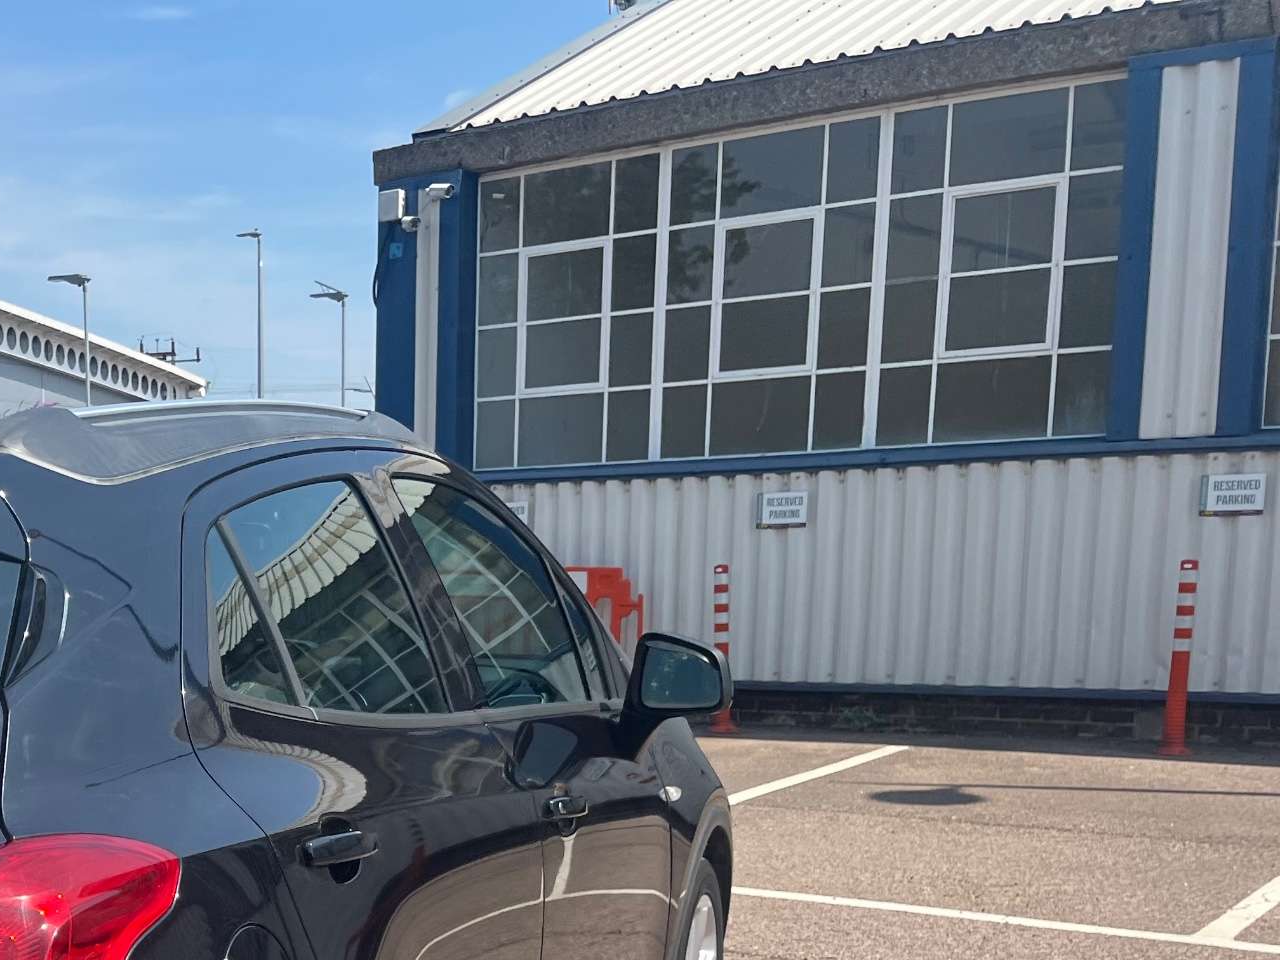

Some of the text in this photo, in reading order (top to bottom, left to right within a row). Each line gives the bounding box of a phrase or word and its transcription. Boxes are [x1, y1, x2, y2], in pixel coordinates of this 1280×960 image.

[1213, 479, 1261, 491] RESERVED
[766, 496, 804, 507] RESERVED
[1216, 494, 1256, 505] PARKING
[769, 509, 800, 519] PARKING
